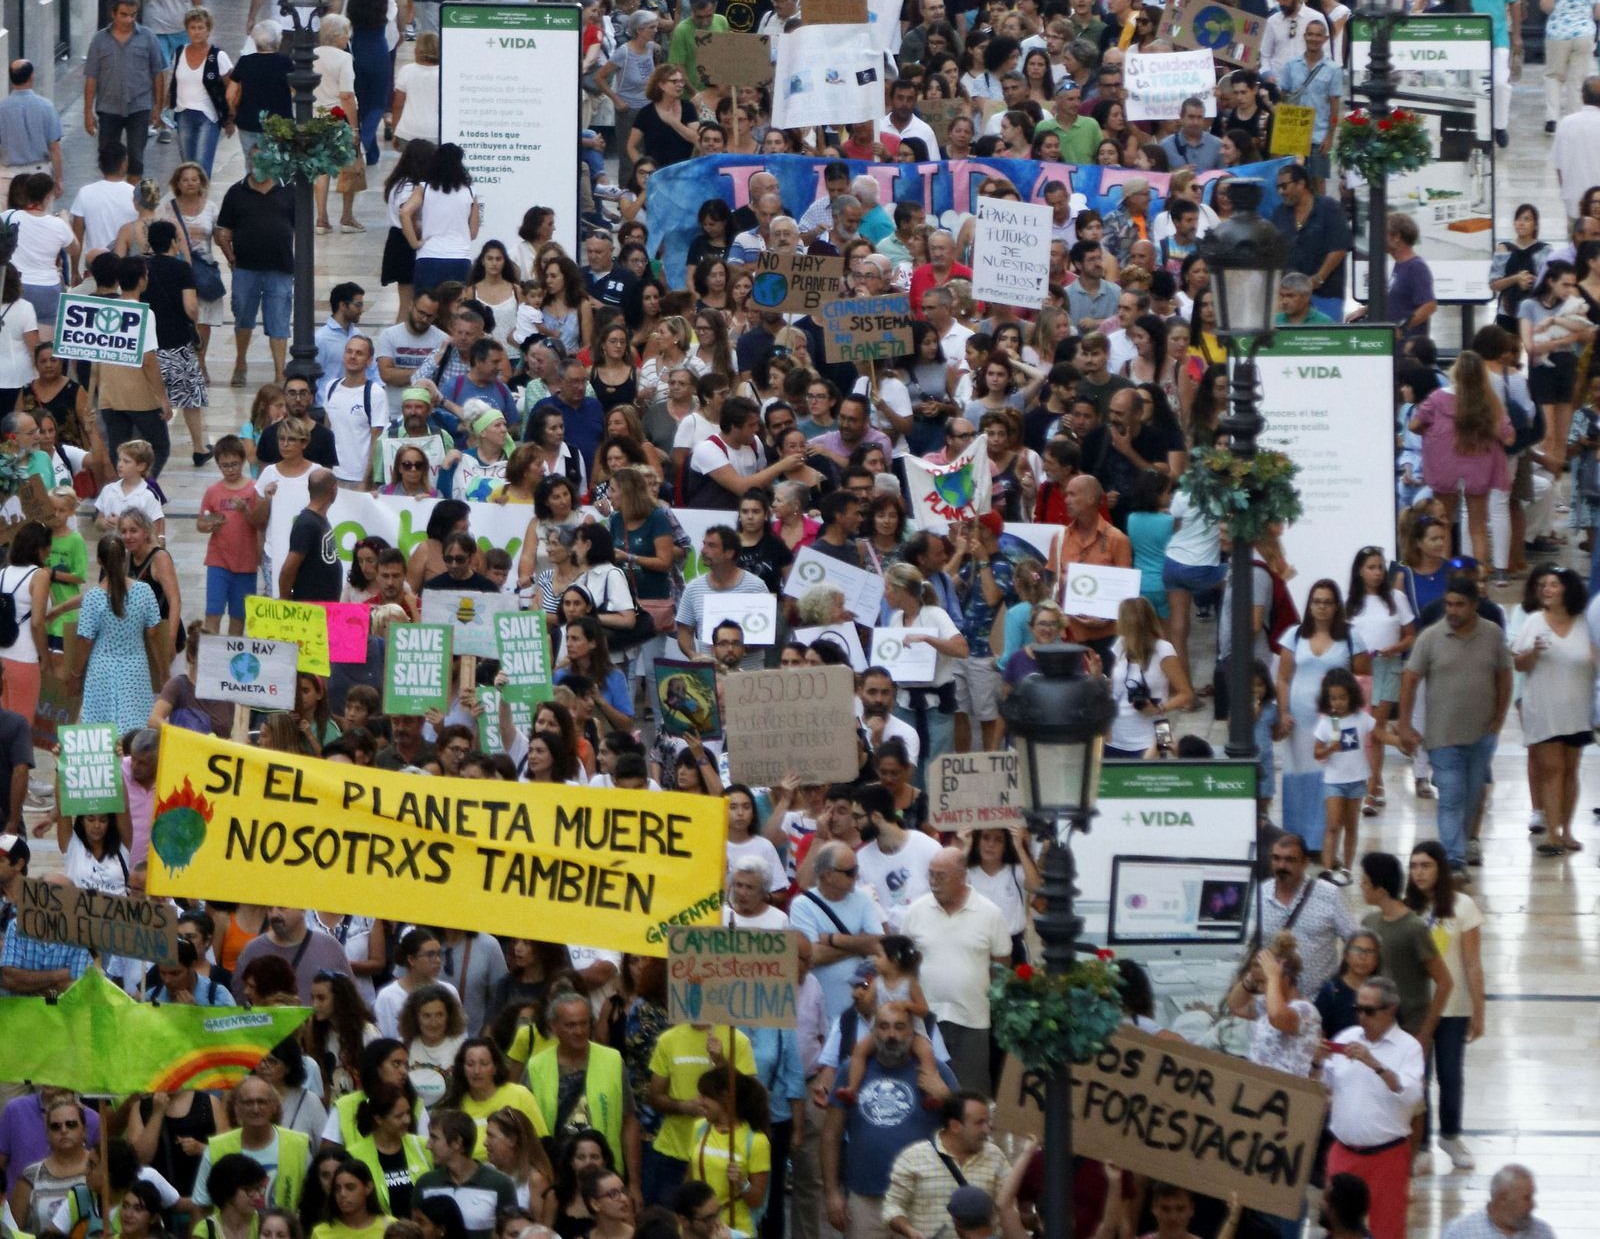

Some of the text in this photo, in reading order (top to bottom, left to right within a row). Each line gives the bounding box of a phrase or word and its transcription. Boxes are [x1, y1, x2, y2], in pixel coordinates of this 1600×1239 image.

[499, 37, 537, 49] VIDA
[1410, 49, 1448, 61] VIDA
[1128, 58, 1145, 76] Si
[505, 85, 516, 93] de
[467, 131, 489, 139] todos
[491, 131, 503, 139] los
[505, 132, 520, 140] que
[516, 143, 541, 151] frenar
[468, 153, 496, 162] cáncer
[513, 154, 531, 162] más
[1024, 216, 1038, 227] EL
[987, 228, 1039, 247] FUTURO
[1000, 245, 1022, 258] DE
[757, 252, 826, 272] NO HAY
[984, 255, 1048, 274] NUESTROS
[791, 275, 840, 292] PLANETA
[997, 273, 1043, 291] HIJOS!
[804, 292, 821, 308] B
[823, 297, 909, 319] CAMBIEMOS
[65, 305, 140, 333] STOP
[851, 315, 912, 333] SISTEMA
[62, 330, 137, 351] ECOCIDE
[58, 345, 138, 363] change the law
[840, 340, 906, 361] PLANETA
[1298, 366, 1342, 379] VIDA
[1267, 423, 1330, 433] sangre oculta
[255, 603, 313, 622] CHILDREN
[499, 616, 542, 639] SAVE
[226, 641, 245, 652] NO
[252, 642, 276, 656] HAY
[395, 628, 444, 652] SAVE
[503, 641, 516, 652] THE
[517, 640, 543, 651] PLANET
[397, 652, 444, 663] THE PLANET
[502, 651, 545, 675] SAVE
[393, 663, 443, 687] SAVE
[517, 674, 547, 684] ANIMALS
[220, 681, 267, 694] PLANETA
[395, 687, 443, 697] THE ANIMALS
[63, 729, 113, 754] SAVE
[67, 753, 115, 765] THE PLANET
[941, 756, 980, 776] POLL
[65, 764, 116, 790] SAVE
[942, 773, 1019, 793] ED N
[1216, 780, 1246, 790] aecc
[68, 788, 117, 799] THE ANIMALS
[939, 794, 949, 811] S
[204, 753, 694, 860] SI EL PLANETA MUERE
[932, 809, 974, 824] WHAT'S
[1139, 810, 1195, 827] VIDA
[224, 816, 656, 915] NOSOTRXS TAMBIÉN
[22, 880, 168, 930] NOS ALZAMOS
[20, 909, 68, 943] COMO
[77, 916, 94, 949] EL
[670, 929, 787, 955] CAMBIEMOS
[671, 956, 786, 979] el sistema
[671, 982, 703, 1020] NO
[727, 980, 797, 1020] CLIMA
[205, 1016, 272, 1032] GREENPEACE
[1155, 1053, 1292, 1128] POR LA
[1018, 1066, 1306, 1188] RFORESTACIÓN
